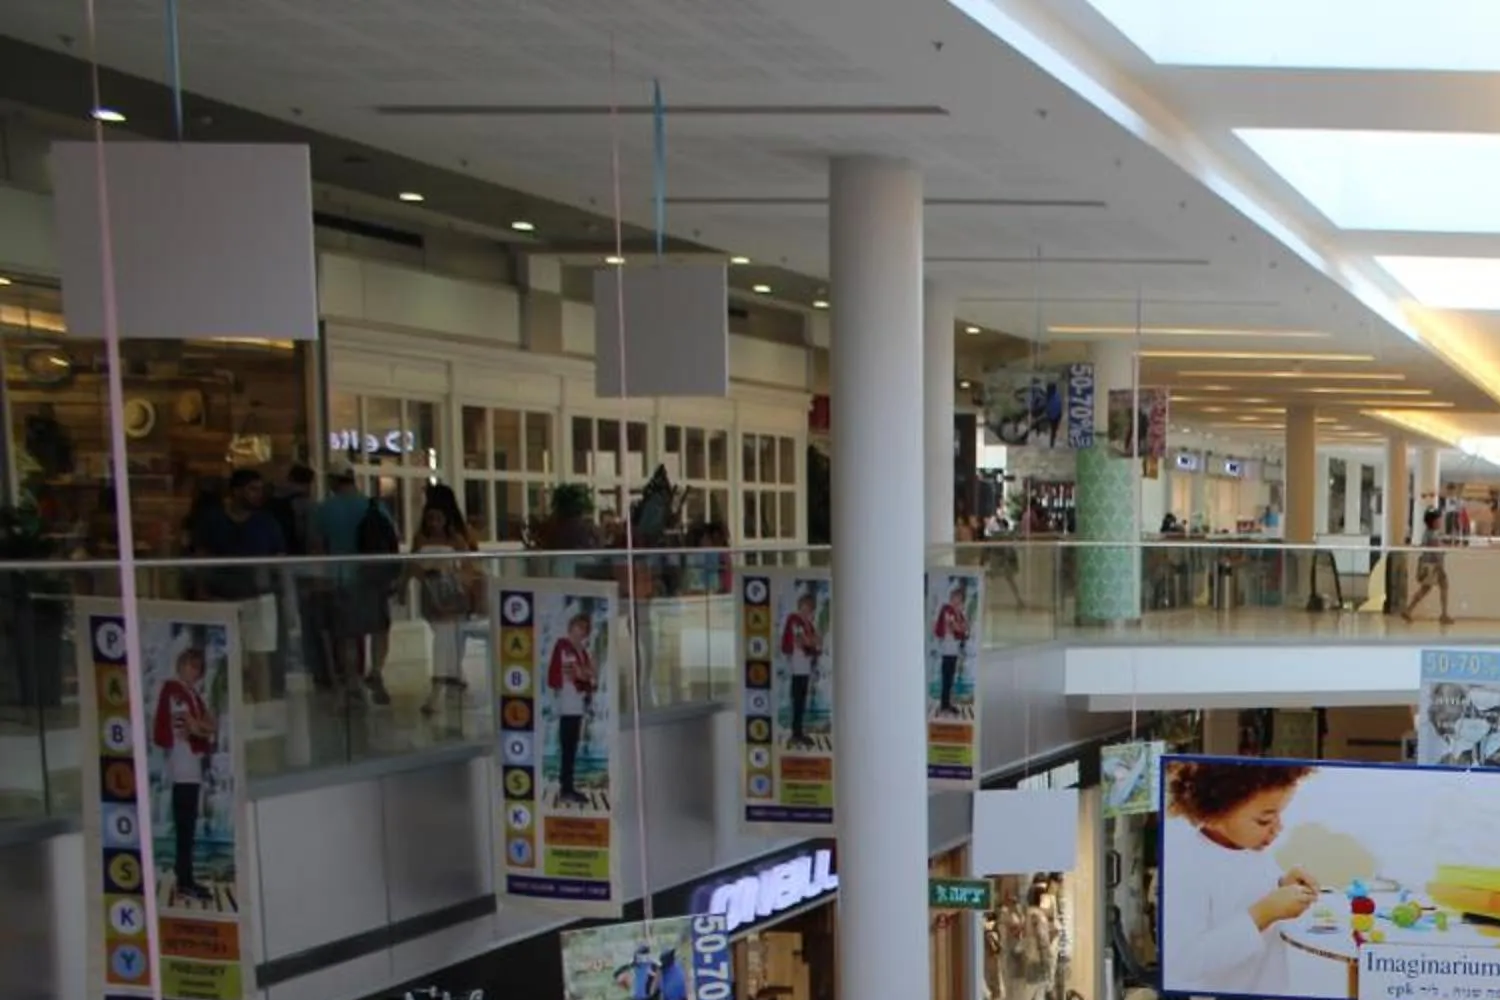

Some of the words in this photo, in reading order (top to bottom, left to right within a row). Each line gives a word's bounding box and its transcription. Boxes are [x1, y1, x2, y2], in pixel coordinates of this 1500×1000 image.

[1070, 364, 1092, 436] 50-70%
[1425, 653, 1498, 676] 50-70%
[1387, 983, 1415, 999] epk
